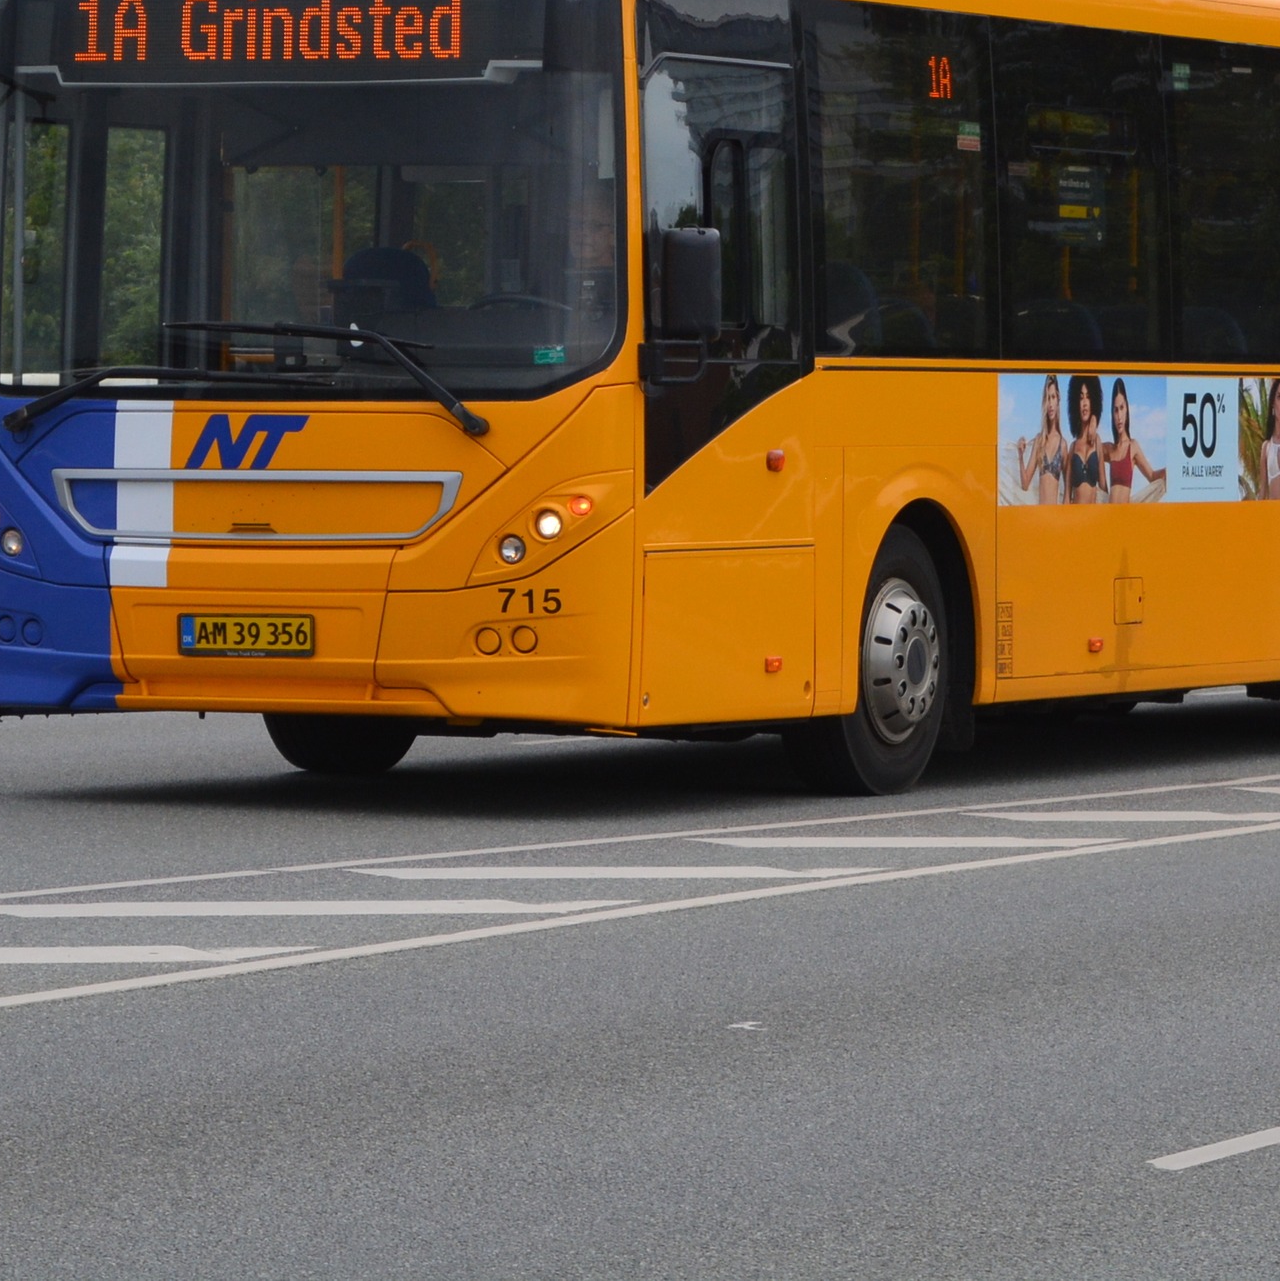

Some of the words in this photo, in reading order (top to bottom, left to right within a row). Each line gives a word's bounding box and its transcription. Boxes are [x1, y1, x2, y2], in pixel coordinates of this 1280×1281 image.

[928, 55, 953, 99] 1A
[183, 413, 310, 470] NT
[1191, 465, 1204, 478] ALLE
[497, 588, 562, 614] 715
[182, 635, 193, 643] DK
[196, 621, 227, 646] AM
[233, 621, 261, 646] 39
[266, 621, 308, 646] 356
